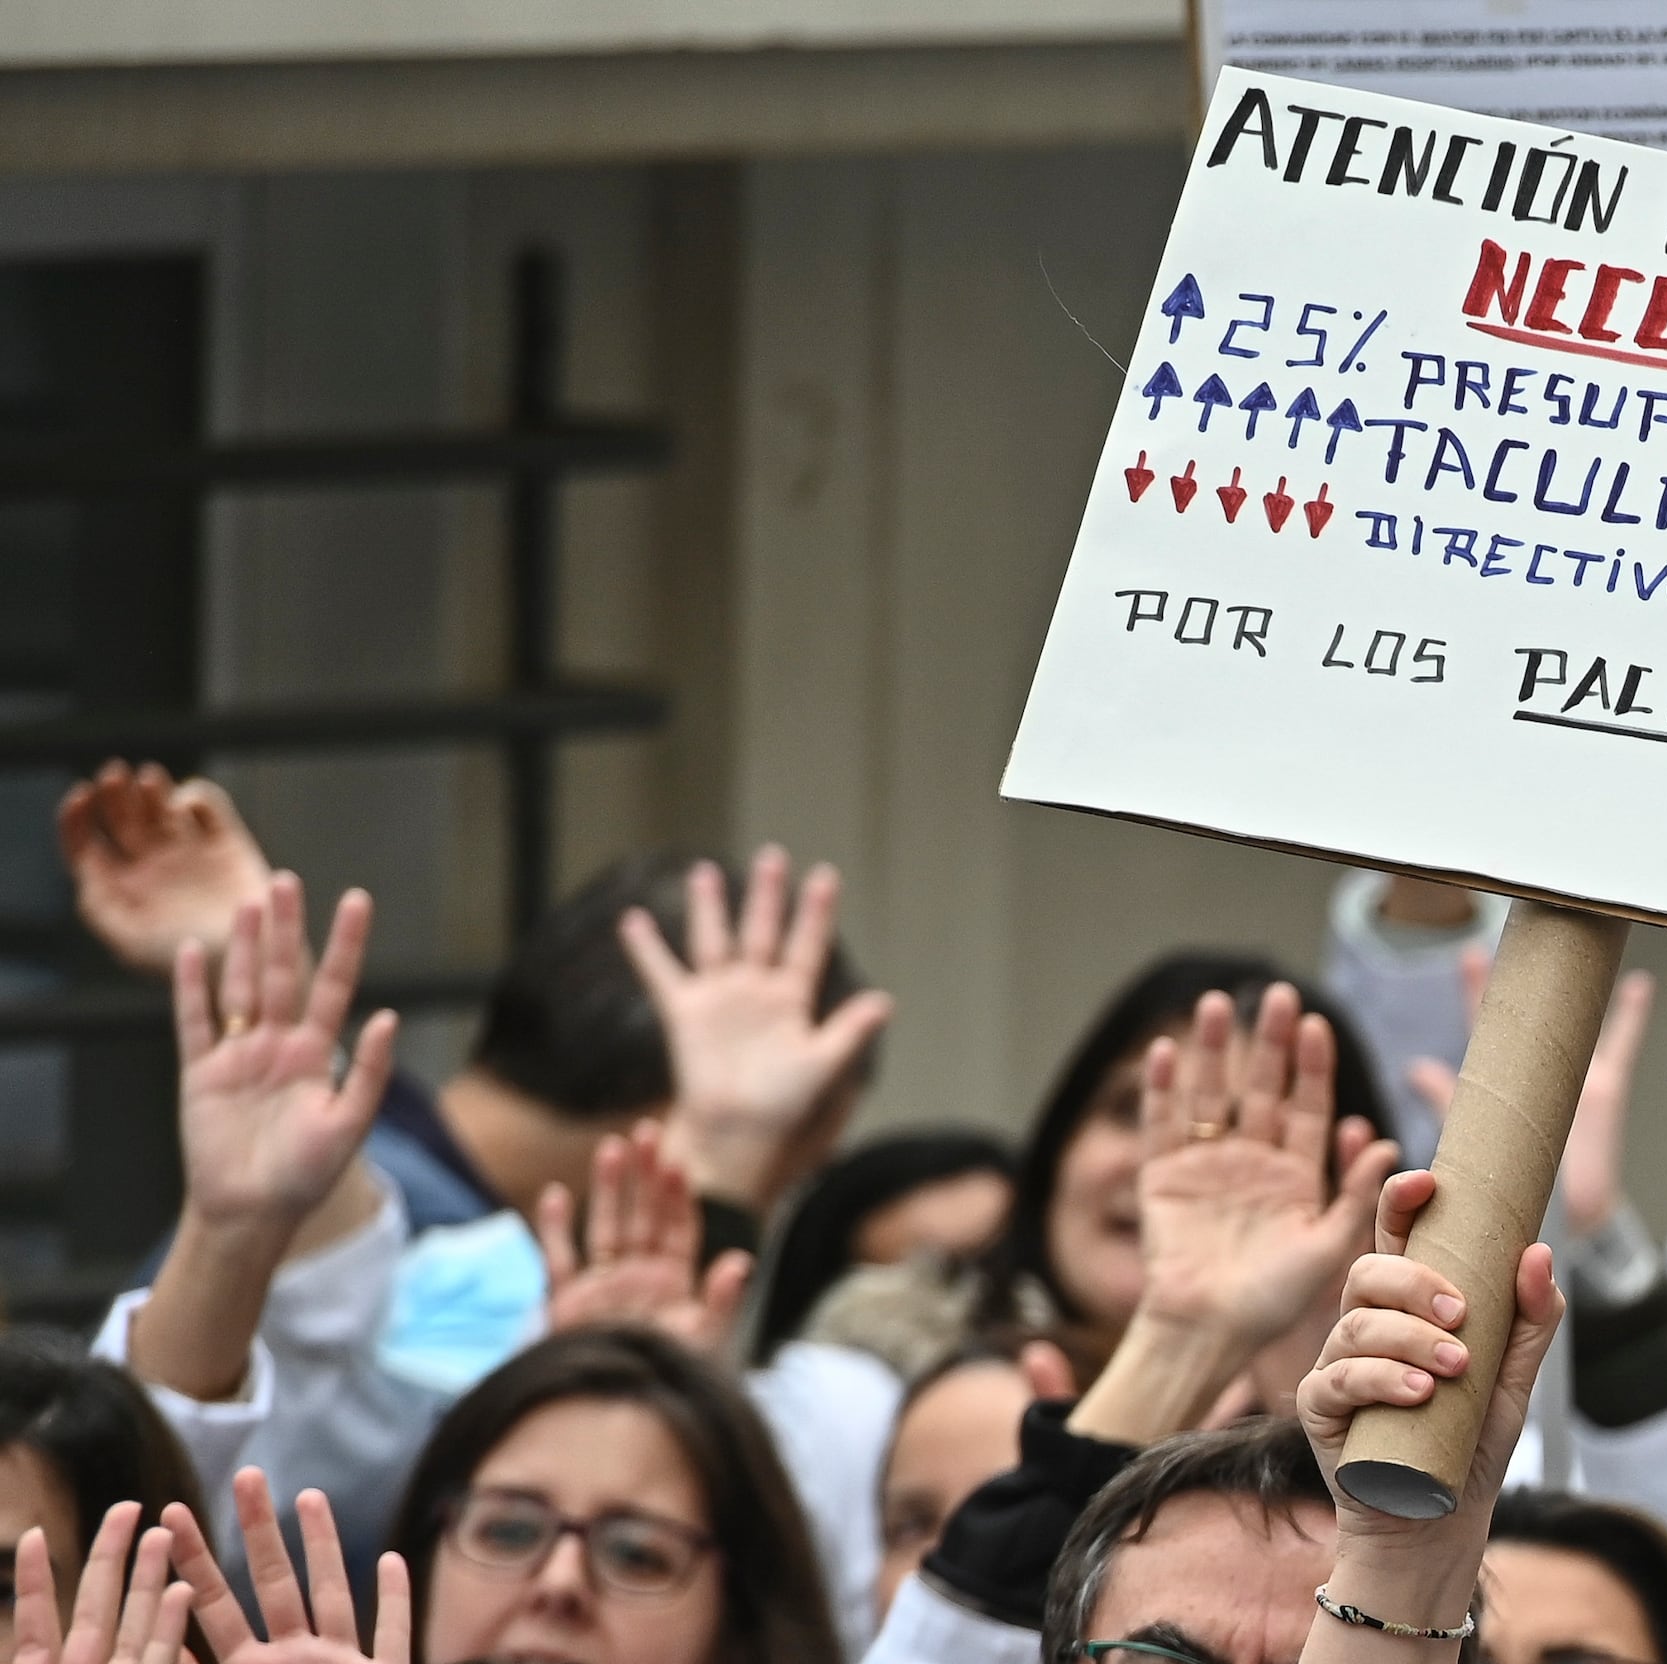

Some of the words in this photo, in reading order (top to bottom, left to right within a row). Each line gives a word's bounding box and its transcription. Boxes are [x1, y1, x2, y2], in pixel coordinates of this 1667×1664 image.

[1206, 88, 1629, 234] ATENCIÓN
[1218, 293, 1389, 375] 25%
[1114, 589, 1273, 658] POR
[1321, 622, 1447, 683] LOS
